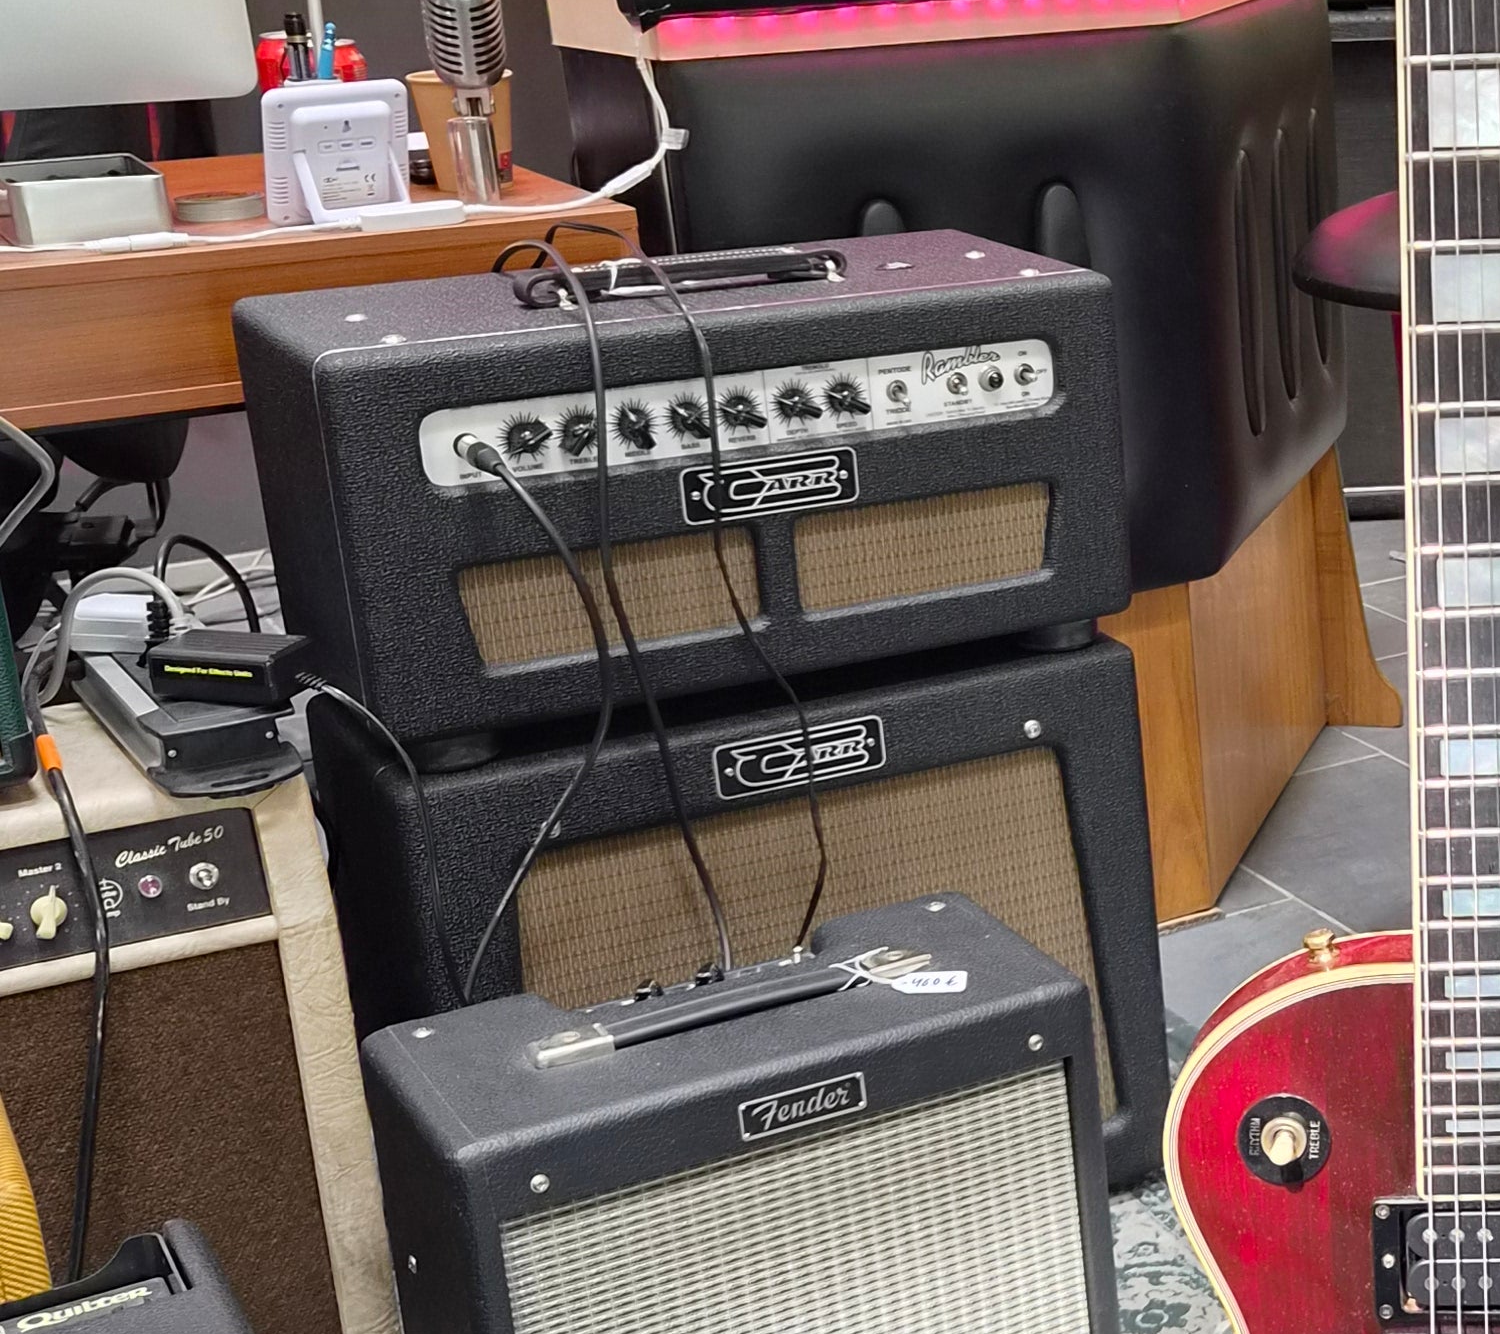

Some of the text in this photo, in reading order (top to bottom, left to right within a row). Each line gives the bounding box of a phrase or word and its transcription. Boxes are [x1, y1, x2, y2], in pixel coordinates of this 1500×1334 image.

[921, 345, 1001, 385] Rambler
[878, 366, 912, 376] PENTODE
[944, 399, 973, 408] STANDBY
[886, 406, 911, 415] TRIODE
[786, 428, 808, 436] DEPTH
[728, 435, 756, 444] REVERB
[681, 442, 700, 450] BASS
[513, 463, 544, 473] VOLUME
[459, 471, 482, 480] INPUT
[698, 455, 841, 514] CARR
[115, 825, 224, 868] Classic Tube 50
[18, 862, 62, 878] Master 2
[187, 896, 230, 912] Stand By
[752, 1086, 850, 1131] Fender
[1308, 1120, 1320, 1160] TREBLE
